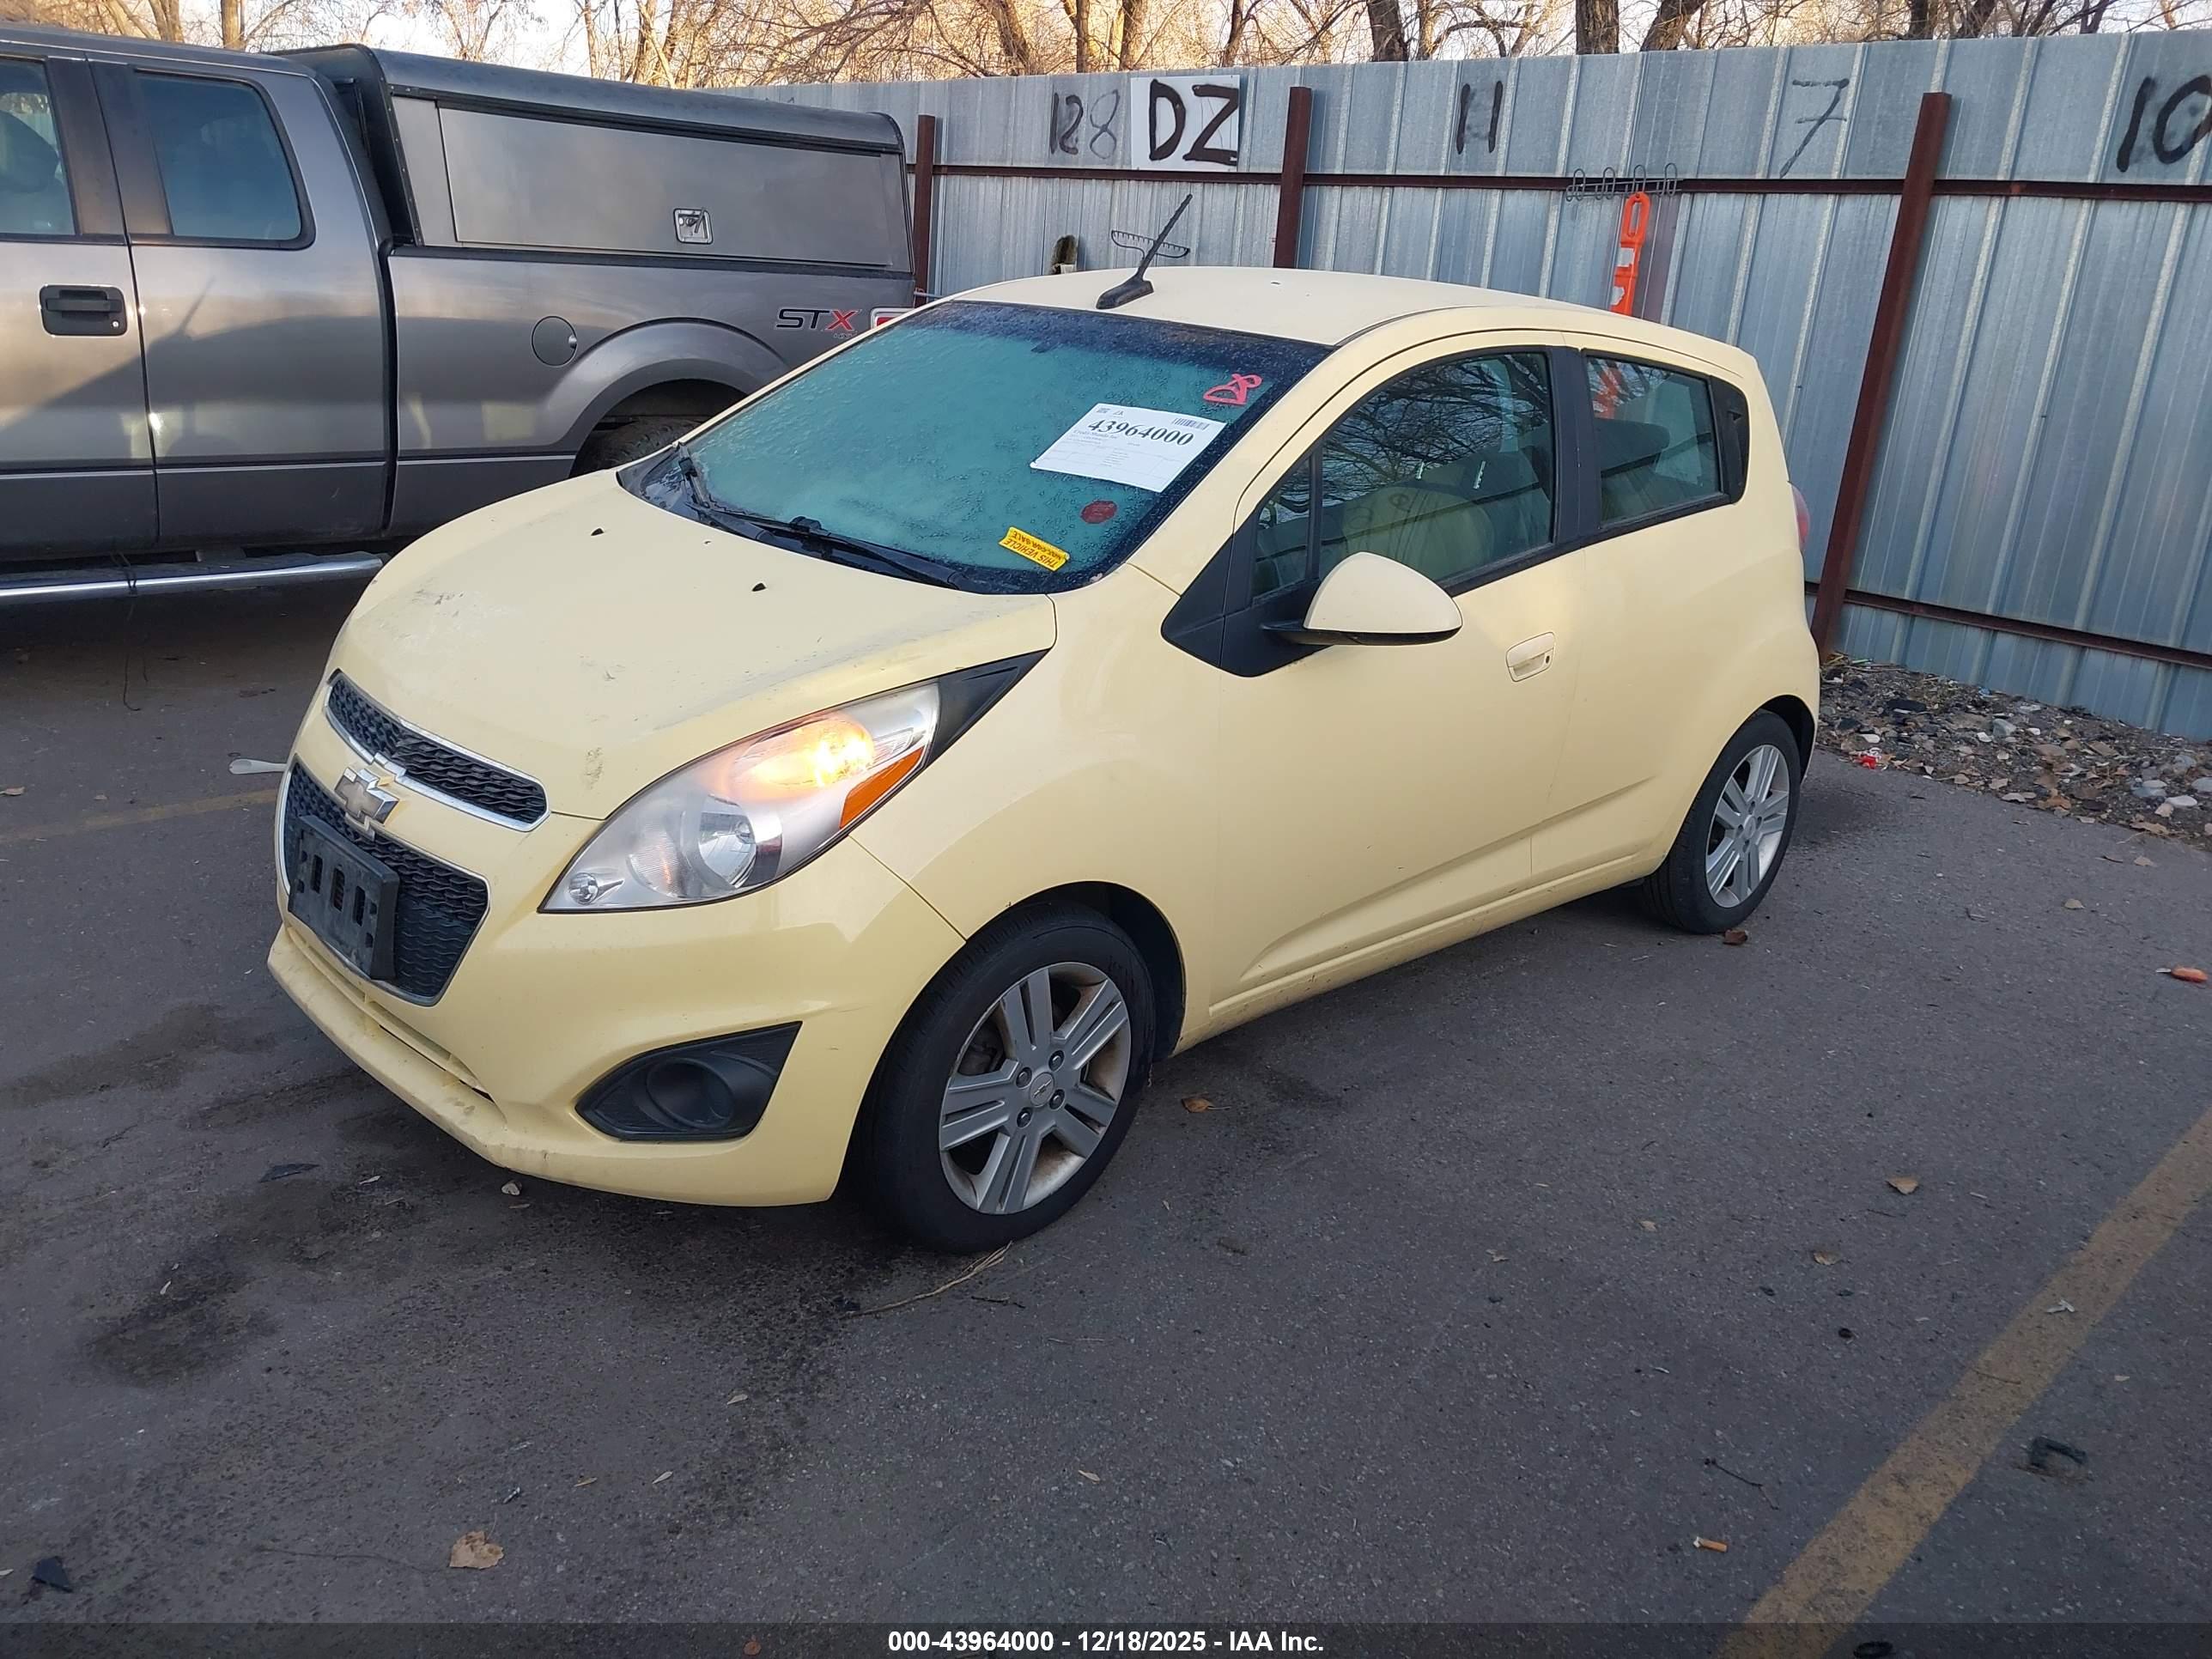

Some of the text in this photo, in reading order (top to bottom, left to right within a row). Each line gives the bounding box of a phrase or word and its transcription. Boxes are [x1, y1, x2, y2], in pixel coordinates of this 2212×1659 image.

[1148, 78, 1239, 166] DZ
[1779, 77, 1850, 179] 7
[2116, 74, 2212, 173] 10
[775, 307, 859, 331] STX
[1087, 419, 1194, 446] 43964000
[1012, 530, 1031, 545] SALE
[1003, 538, 1058, 568] THIS VEHICLE
